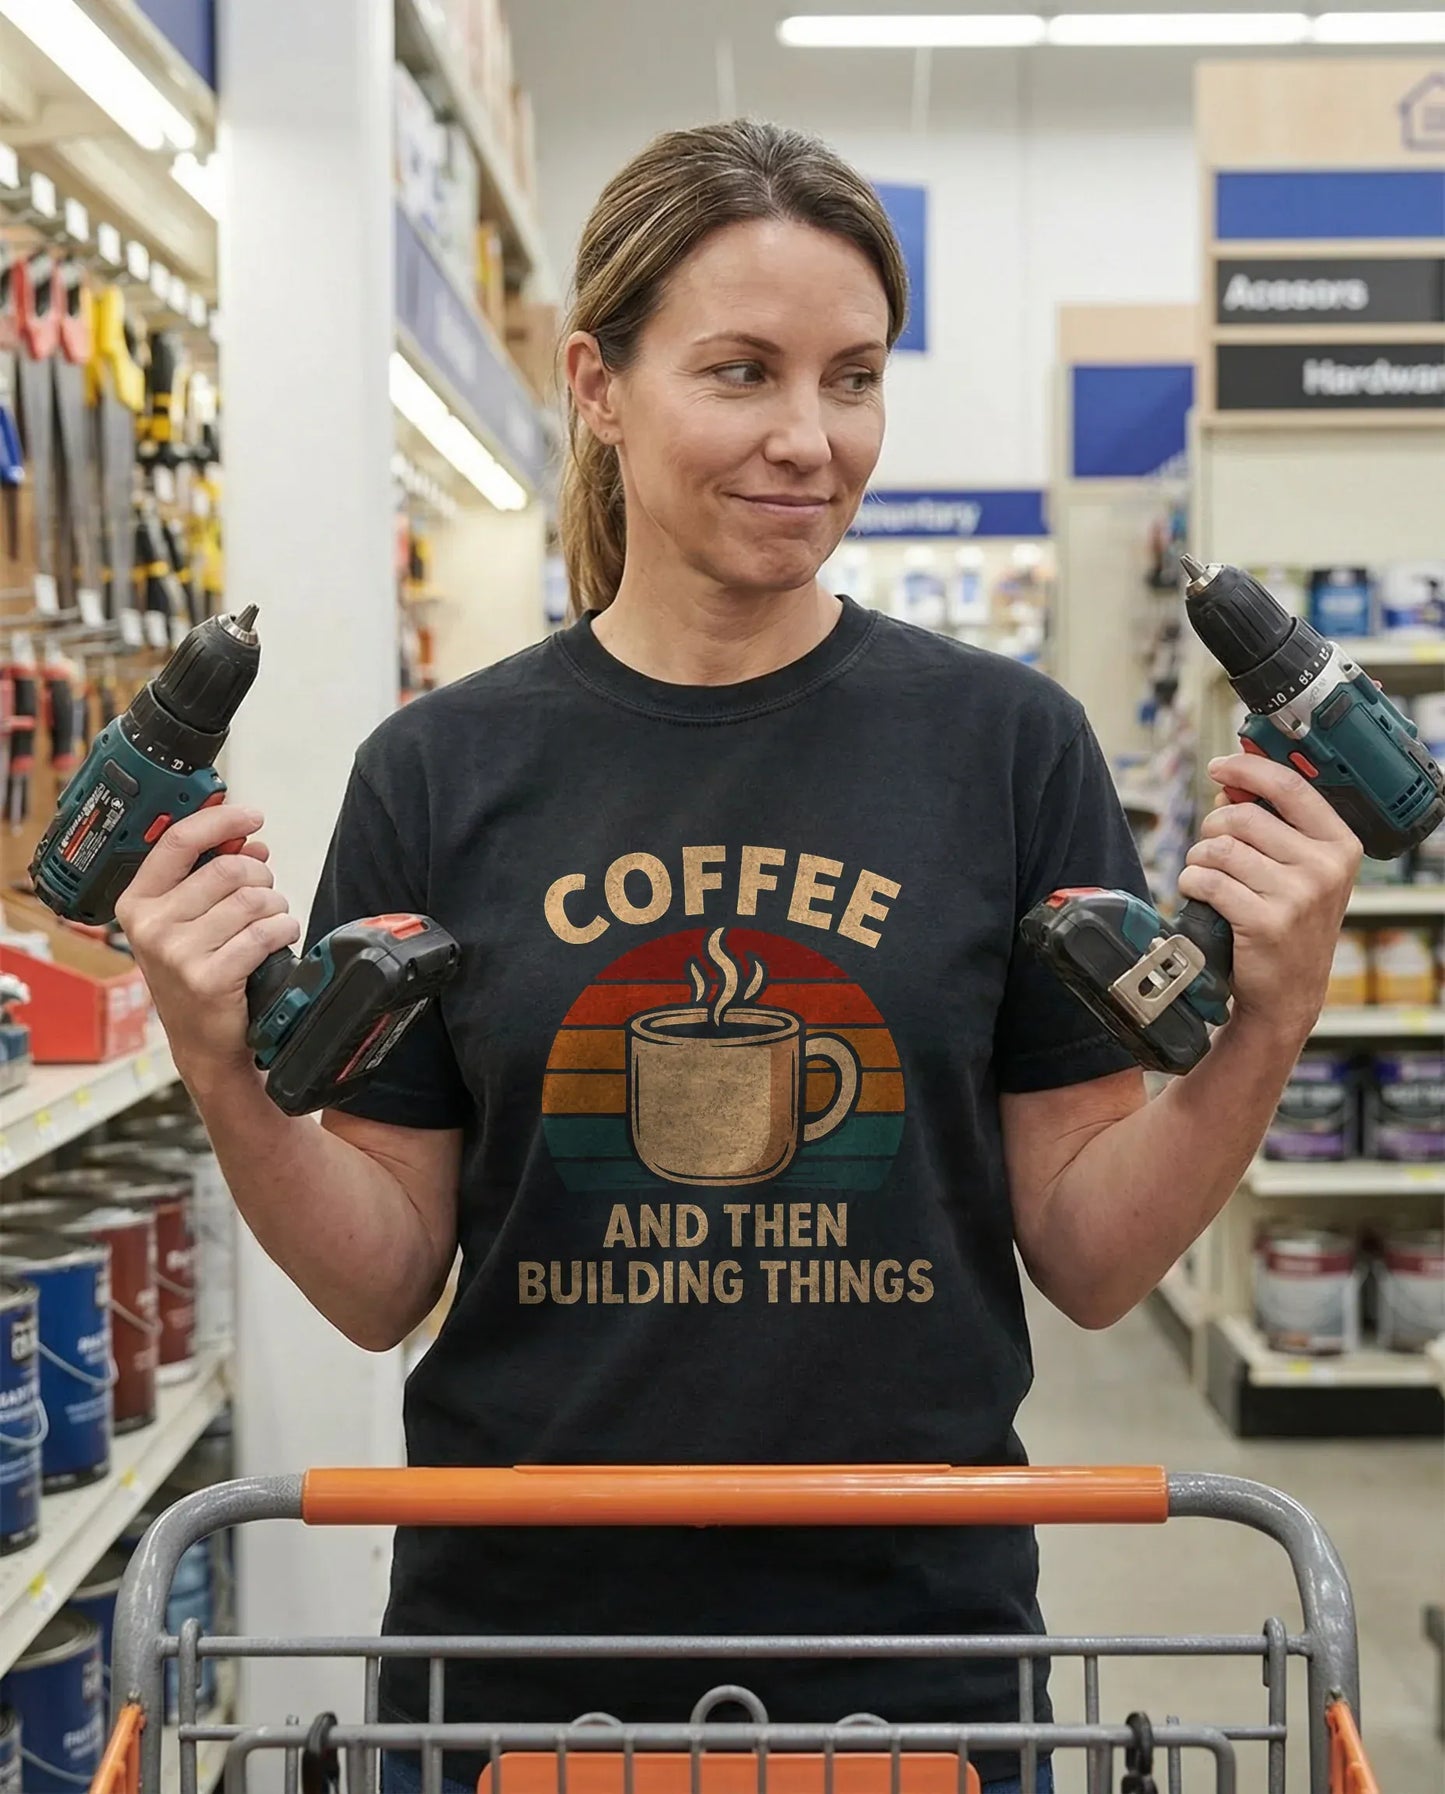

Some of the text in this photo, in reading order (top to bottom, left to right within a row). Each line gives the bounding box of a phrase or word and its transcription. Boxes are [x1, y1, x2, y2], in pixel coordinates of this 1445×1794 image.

[544, 845, 902, 949] COFFEE
[603, 1203, 847, 1247] AND THEN
[519, 1260, 934, 1304] BUILDING THINGS
